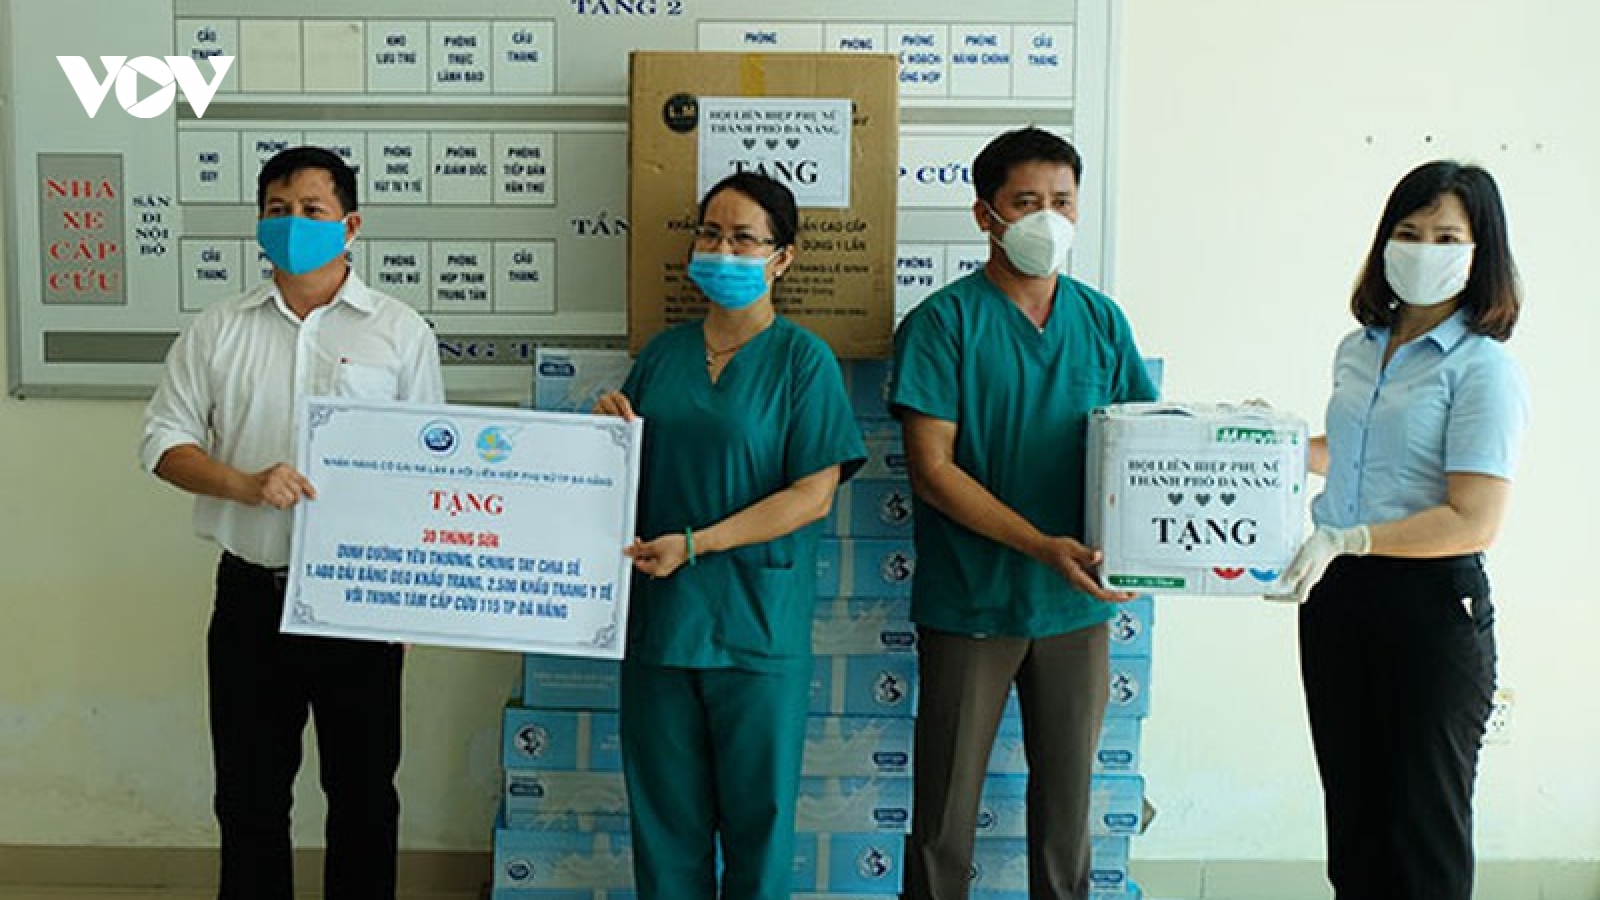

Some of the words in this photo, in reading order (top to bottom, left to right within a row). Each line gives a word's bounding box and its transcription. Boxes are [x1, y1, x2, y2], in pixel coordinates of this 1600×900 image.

[63, 212, 103, 228] XE
[49, 266, 118, 292] CỨU
[1152, 514, 1257, 551] TẶNG
